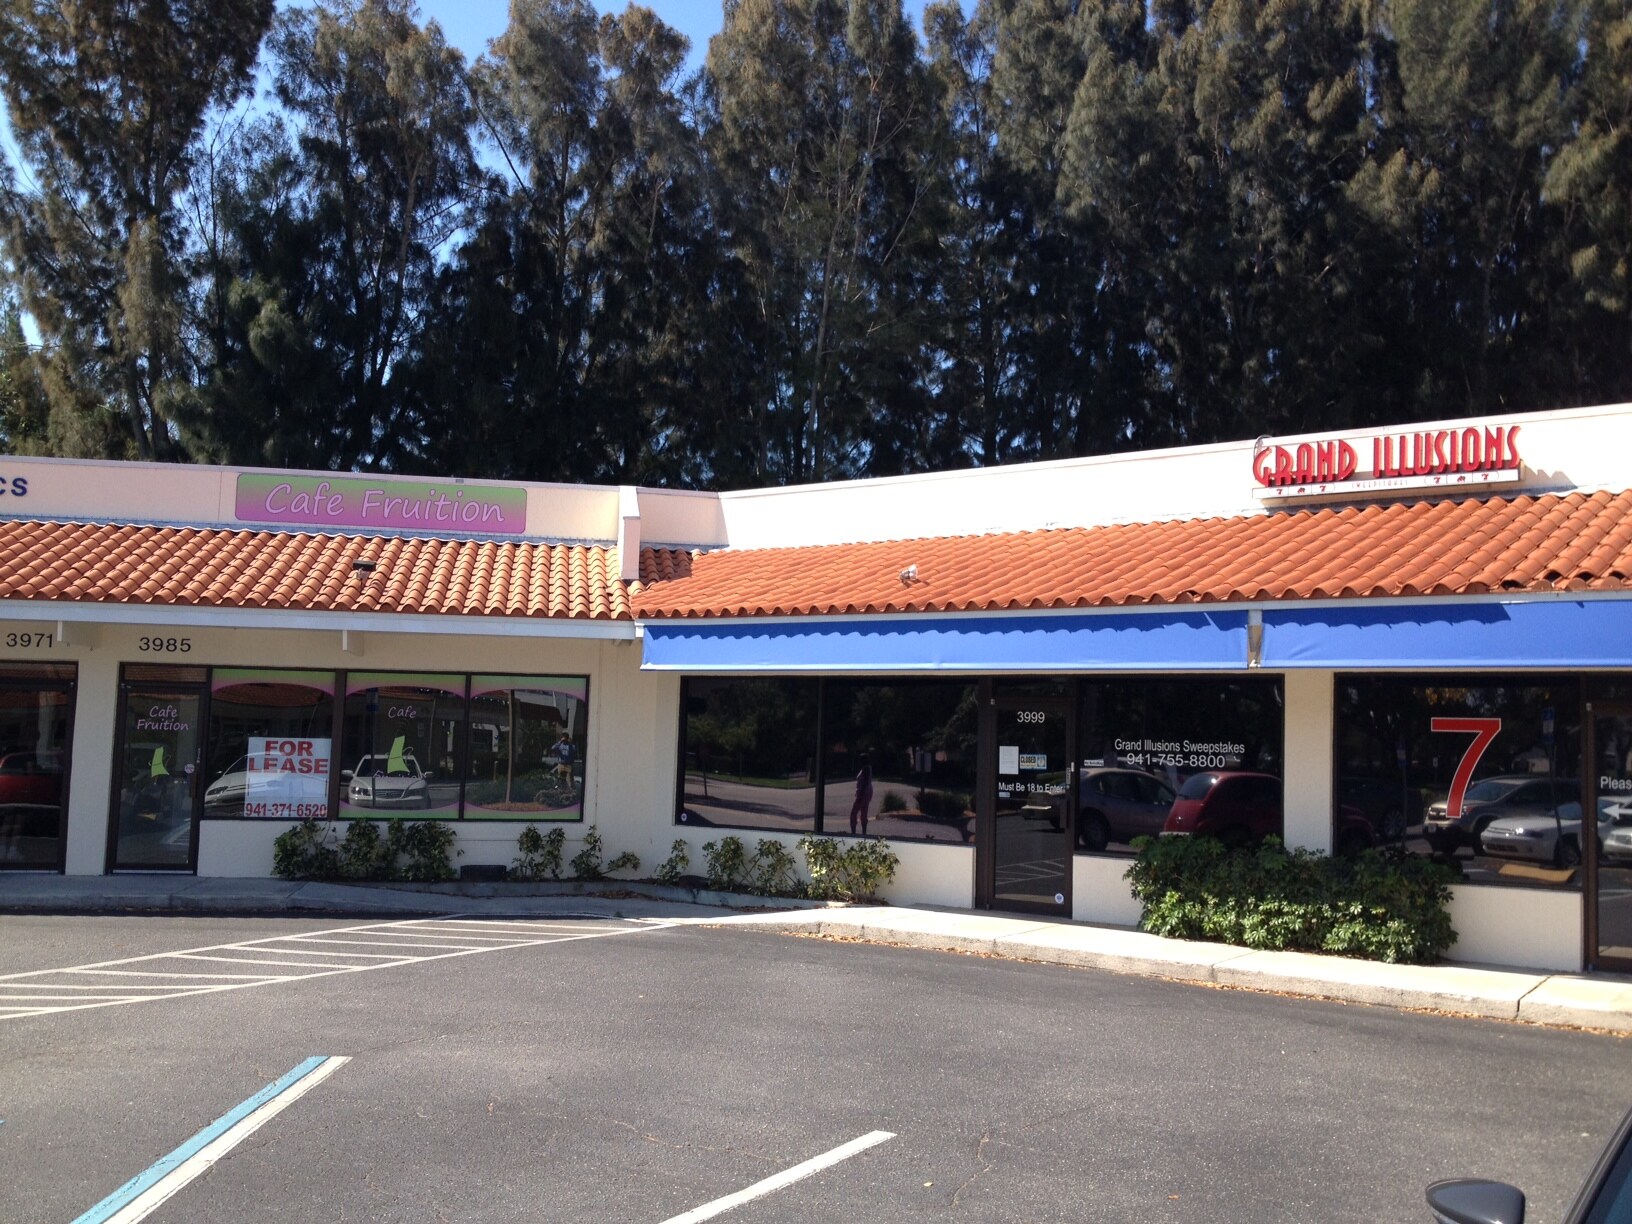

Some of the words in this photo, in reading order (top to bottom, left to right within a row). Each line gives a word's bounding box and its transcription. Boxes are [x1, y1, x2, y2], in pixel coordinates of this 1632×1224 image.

[1252, 438, 1358, 487] GRAND
[1373, 425, 1521, 478] ILLUSIONS
[264, 482, 344, 516] Cafe
[361, 487, 506, 524] Fruition
[5, 632, 54, 649] 3971
[138, 636, 192, 653] 3985
[149, 704, 178, 718] Cafe
[388, 705, 417, 719] Cafe
[1016, 711, 1045, 723] 3999
[137, 718, 189, 731] Fruition
[265, 740, 313, 757] FOR
[1114, 738, 1142, 751] Grand
[1144, 739, 1180, 752] Illusions
[1182, 740, 1245, 755] Sweepstakes
[248, 757, 329, 774] LEASE
[1126, 752, 1226, 768] 941-755-8800
[1431, 716, 1502, 819] 7
[998, 781, 1015, 791] Must
[1016, 782, 1025, 791] Be
[1027, 783, 1035, 792] 18
[1036, 783, 1043, 792] to
[1600, 775, 1632, 790] Pleas
[246, 802, 327, 817] 941-371-6520
